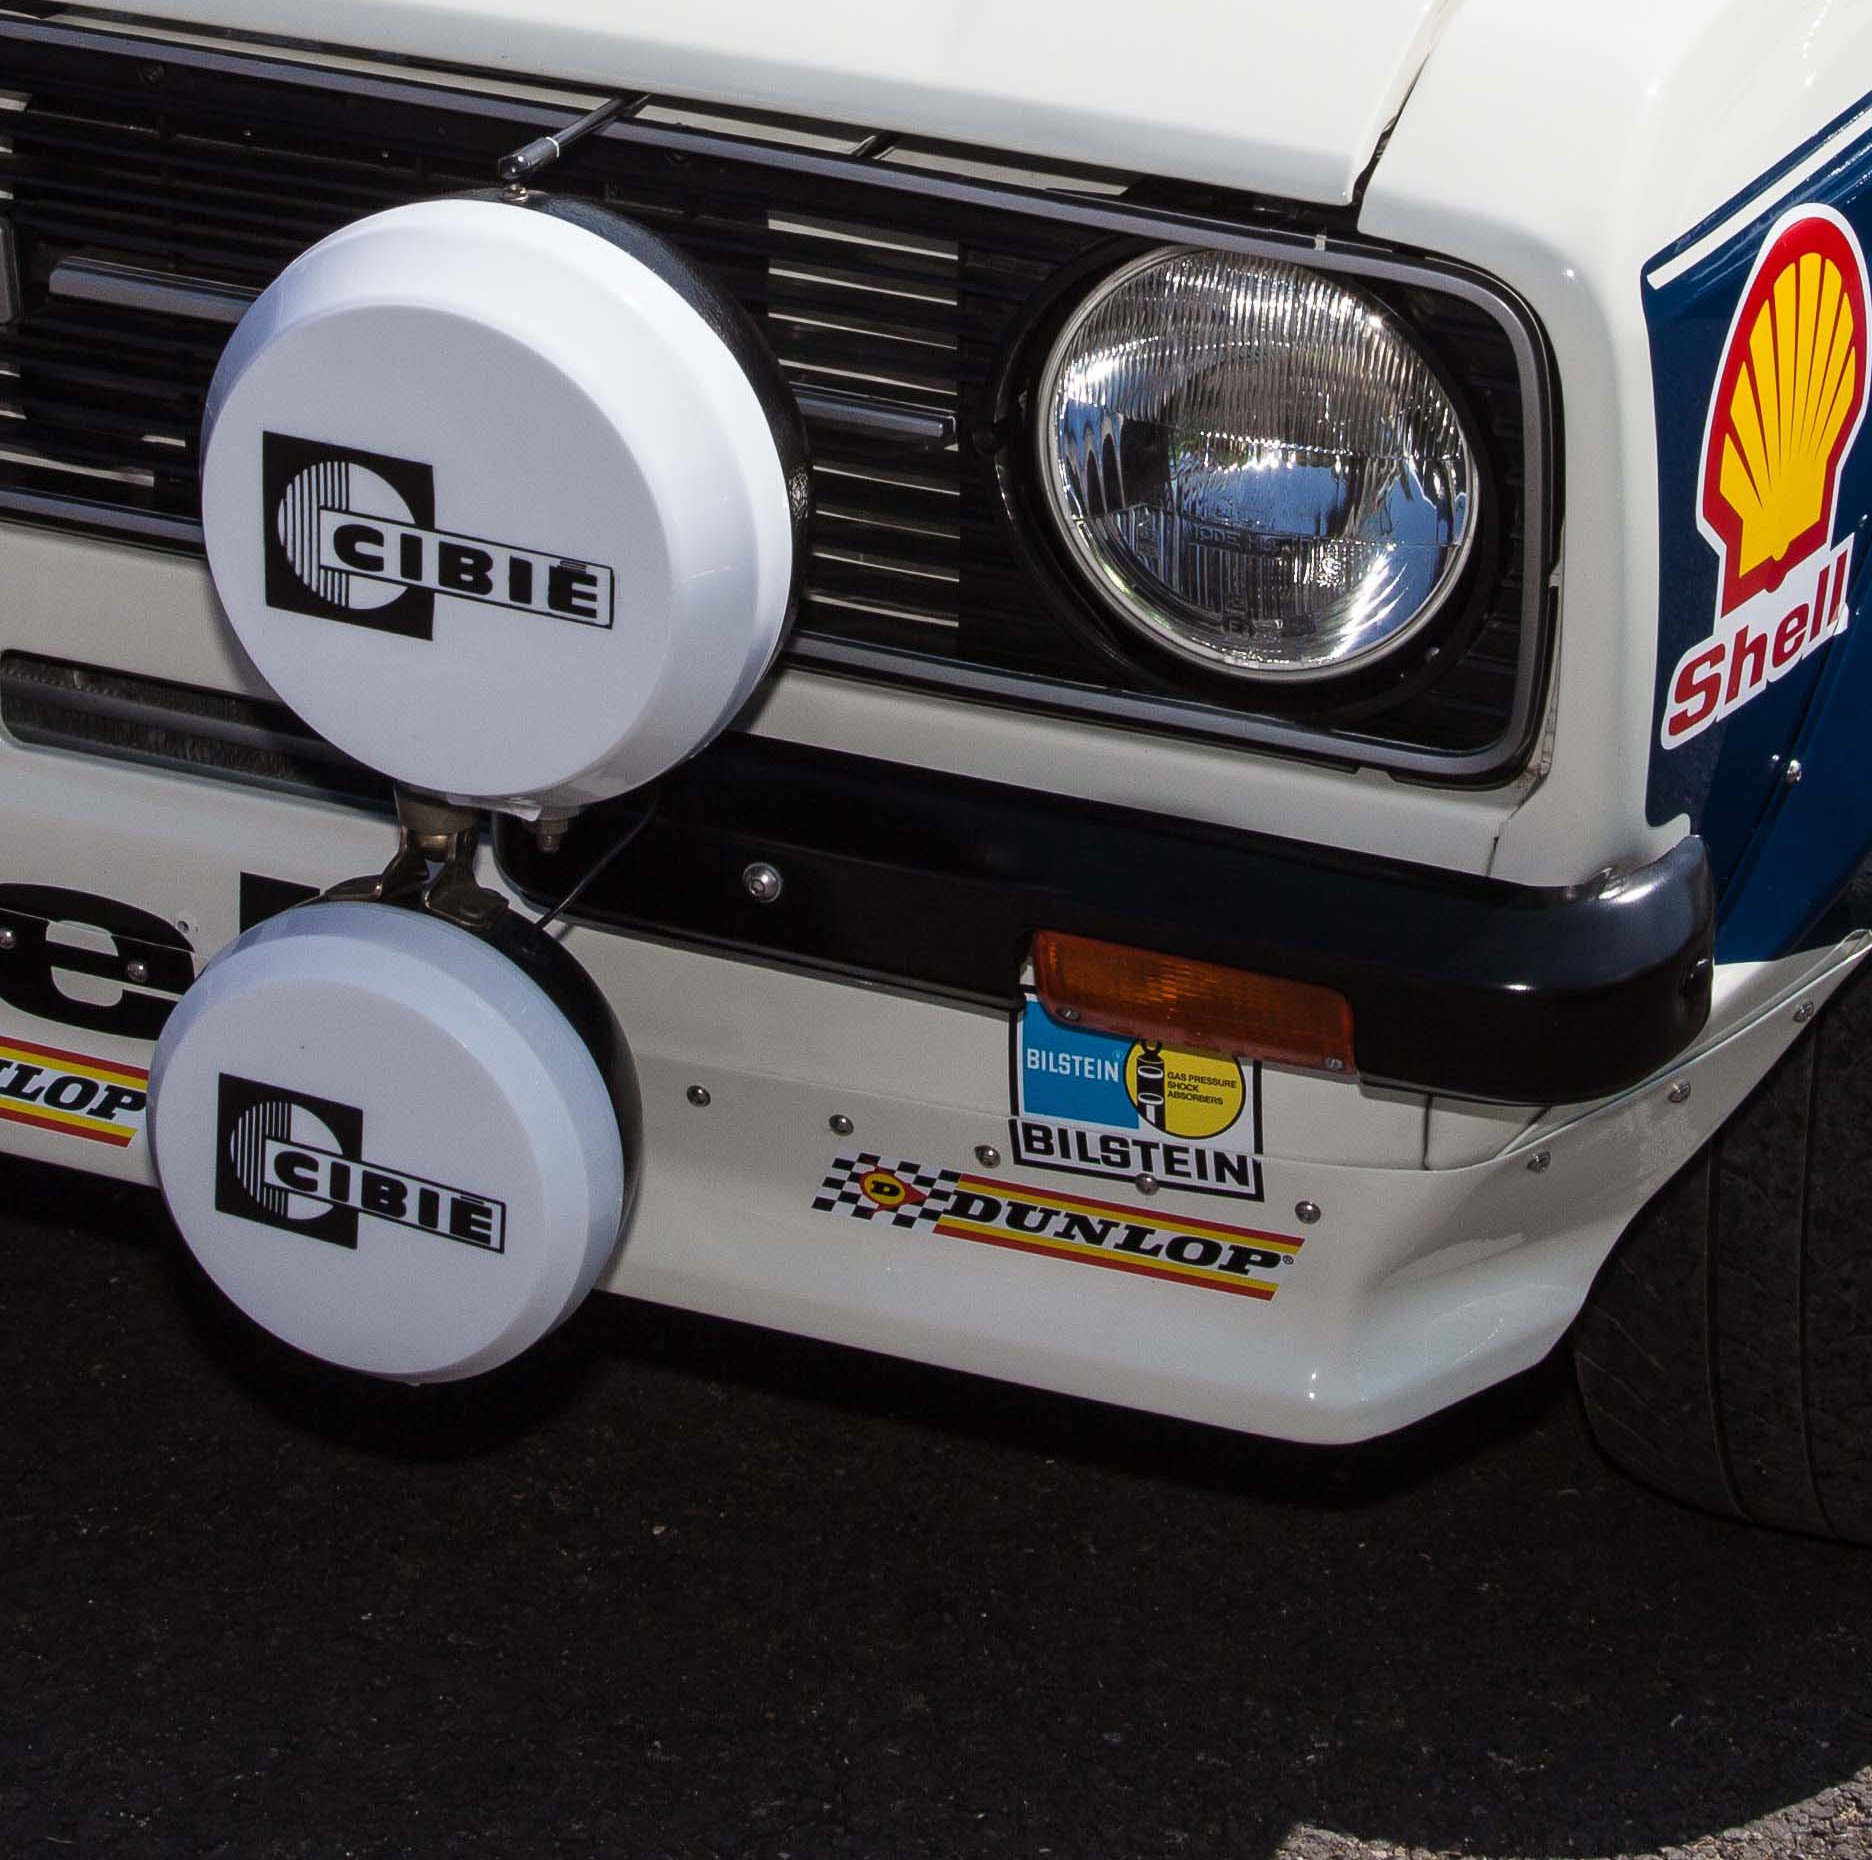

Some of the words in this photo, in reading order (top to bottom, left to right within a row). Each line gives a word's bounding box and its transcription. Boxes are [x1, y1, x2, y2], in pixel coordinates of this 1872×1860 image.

[1668, 548, 1850, 738] Shell
[1027, 1047, 1119, 1083] BILSTEIN
[1167, 1071, 1188, 1083] GAS
[1188, 1074, 1237, 1090] PRESSURE
[1167, 1081, 1200, 1093] SHOCK
[1167, 1090, 1224, 1106] ABSORBERS
[1020, 1121, 1251, 1188] BILSTEIN
[942, 1174, 1283, 1277] DUNLOP
